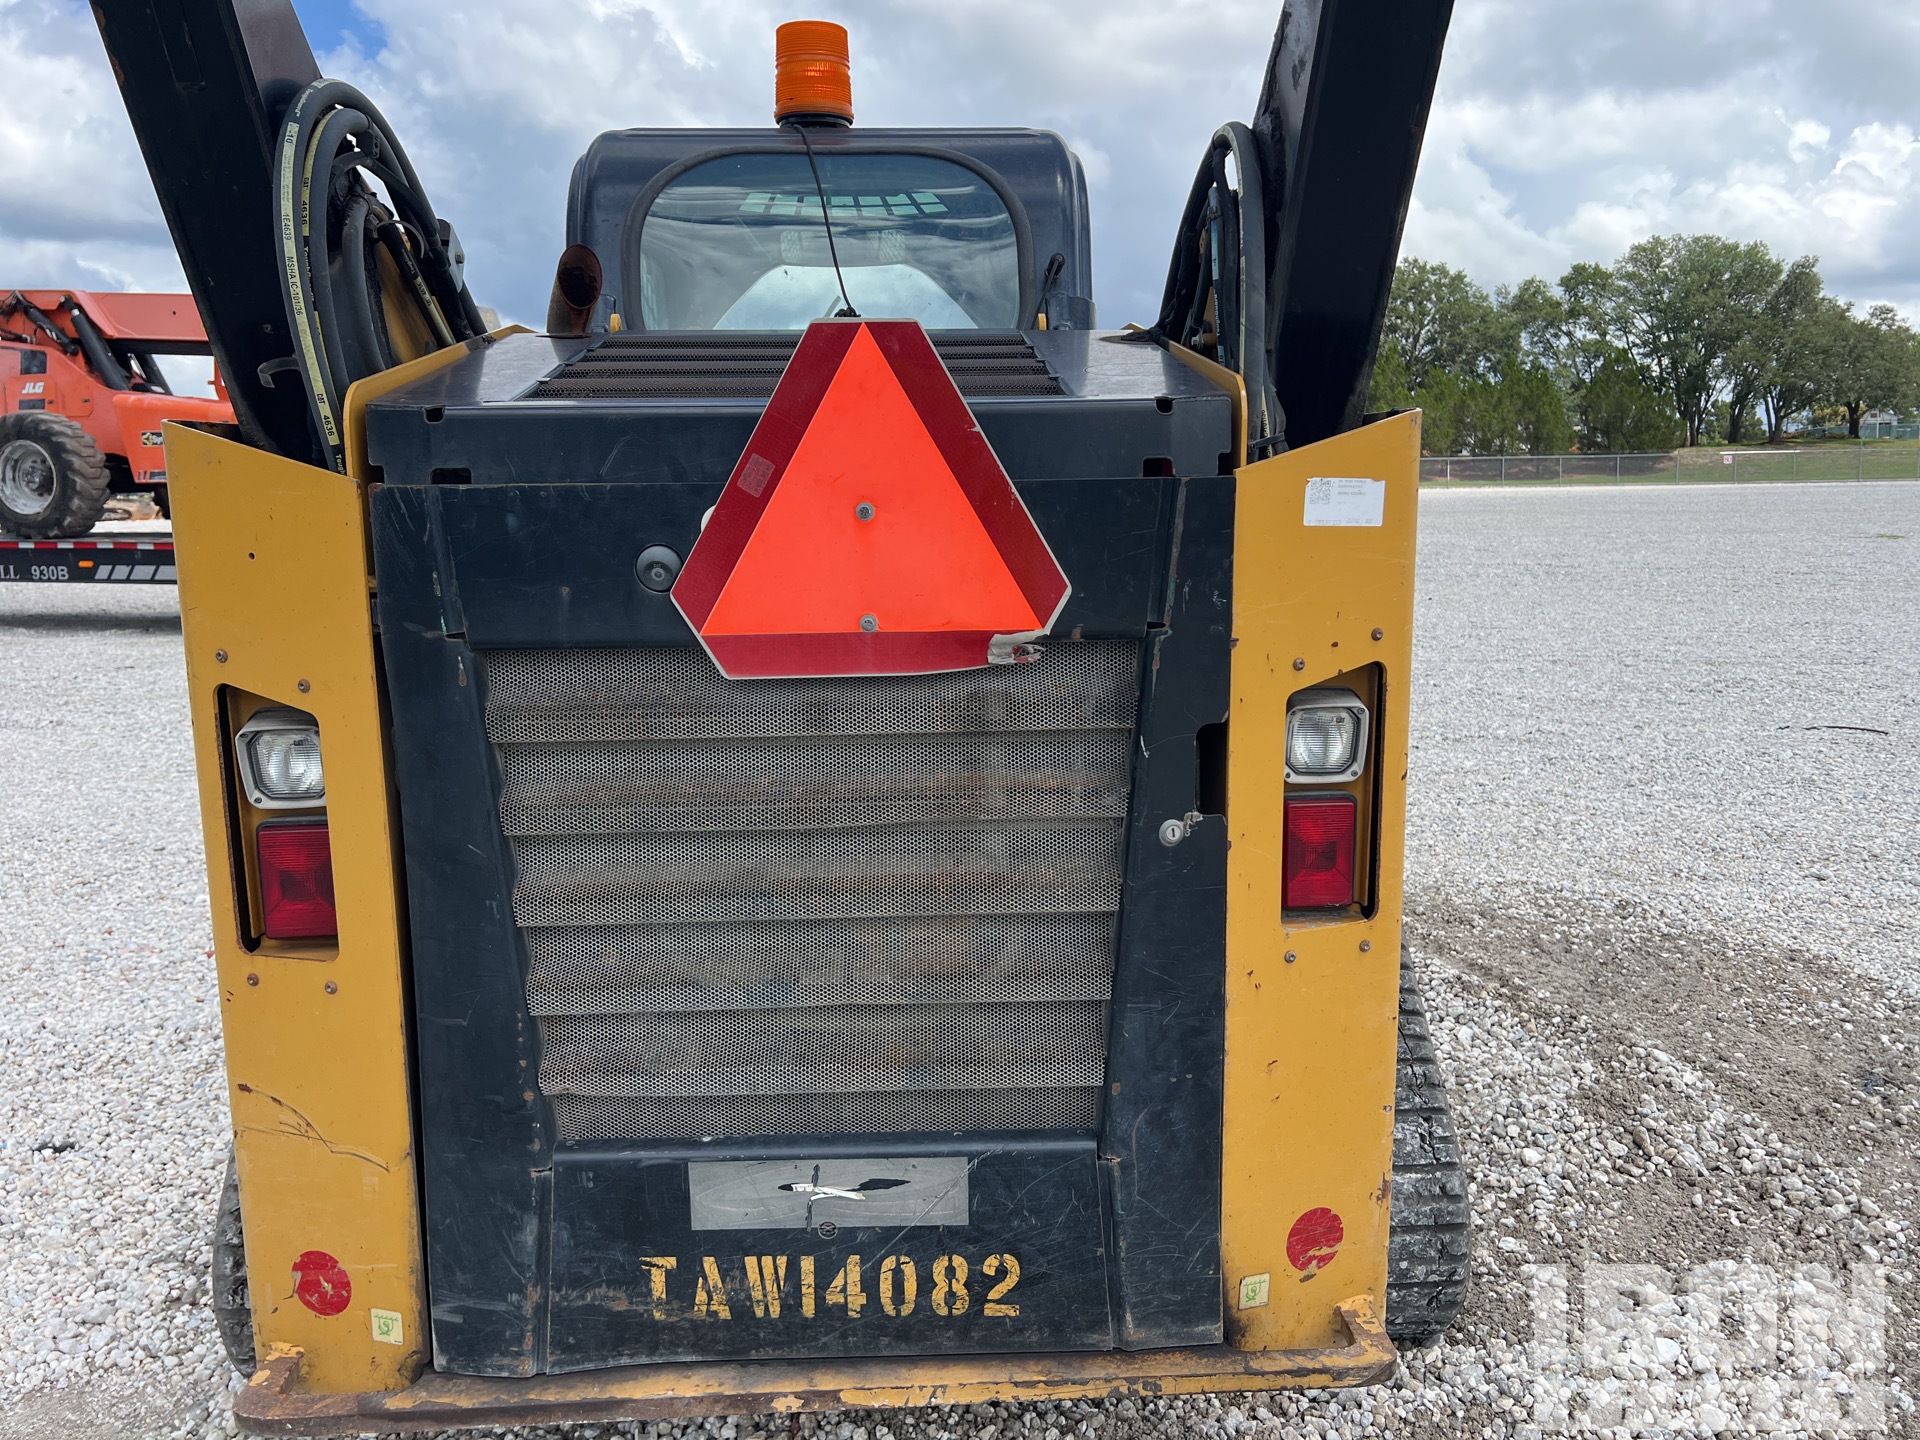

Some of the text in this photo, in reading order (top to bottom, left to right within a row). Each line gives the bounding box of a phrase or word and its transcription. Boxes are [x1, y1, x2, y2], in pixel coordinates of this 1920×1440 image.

[301, 200, 309, 226] 4636
[281, 213, 292, 241] 1E4639
[286, 256, 298, 280] MSHA
[21, 381, 45, 395] JLG
[316, 393, 335, 437] CAT 4636
[31, 565, 69, 581] 930B
